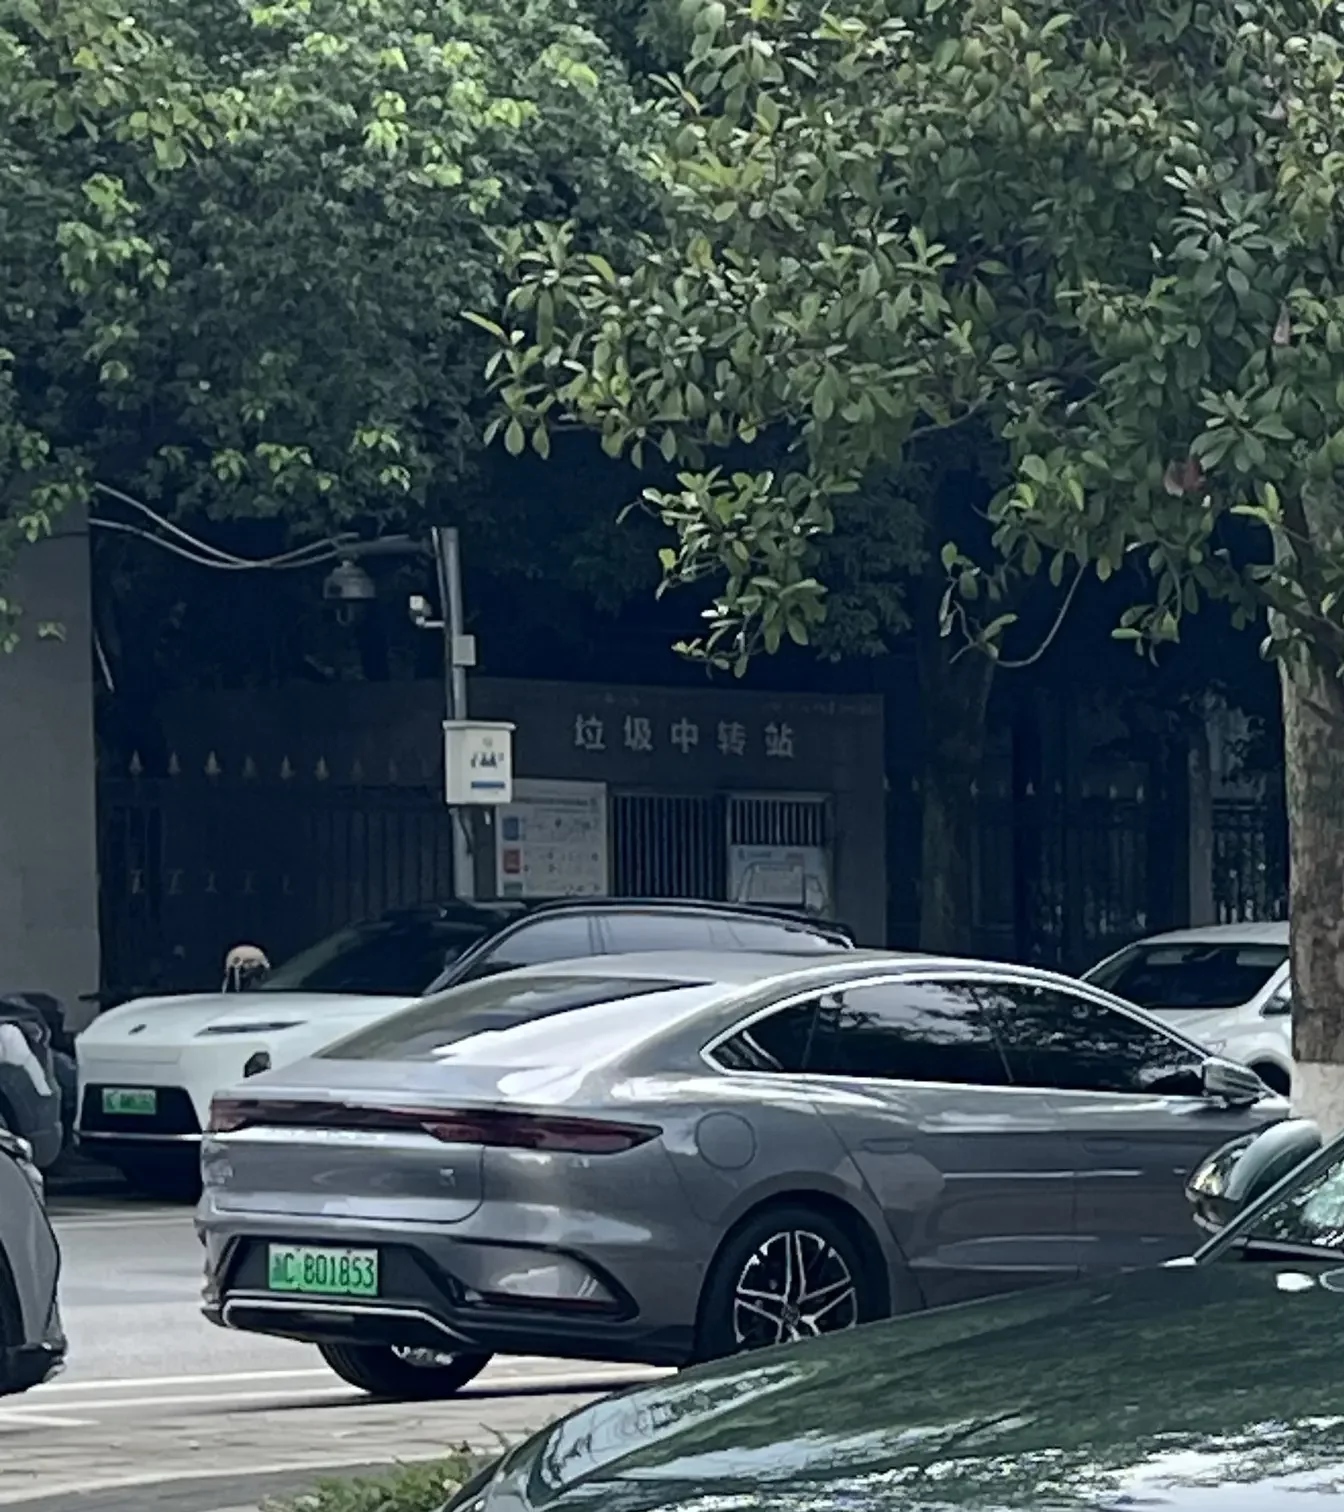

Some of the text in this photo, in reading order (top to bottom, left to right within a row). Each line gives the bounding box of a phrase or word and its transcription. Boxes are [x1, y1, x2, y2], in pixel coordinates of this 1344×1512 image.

[574, 713, 794, 758] 垃圾中转站
